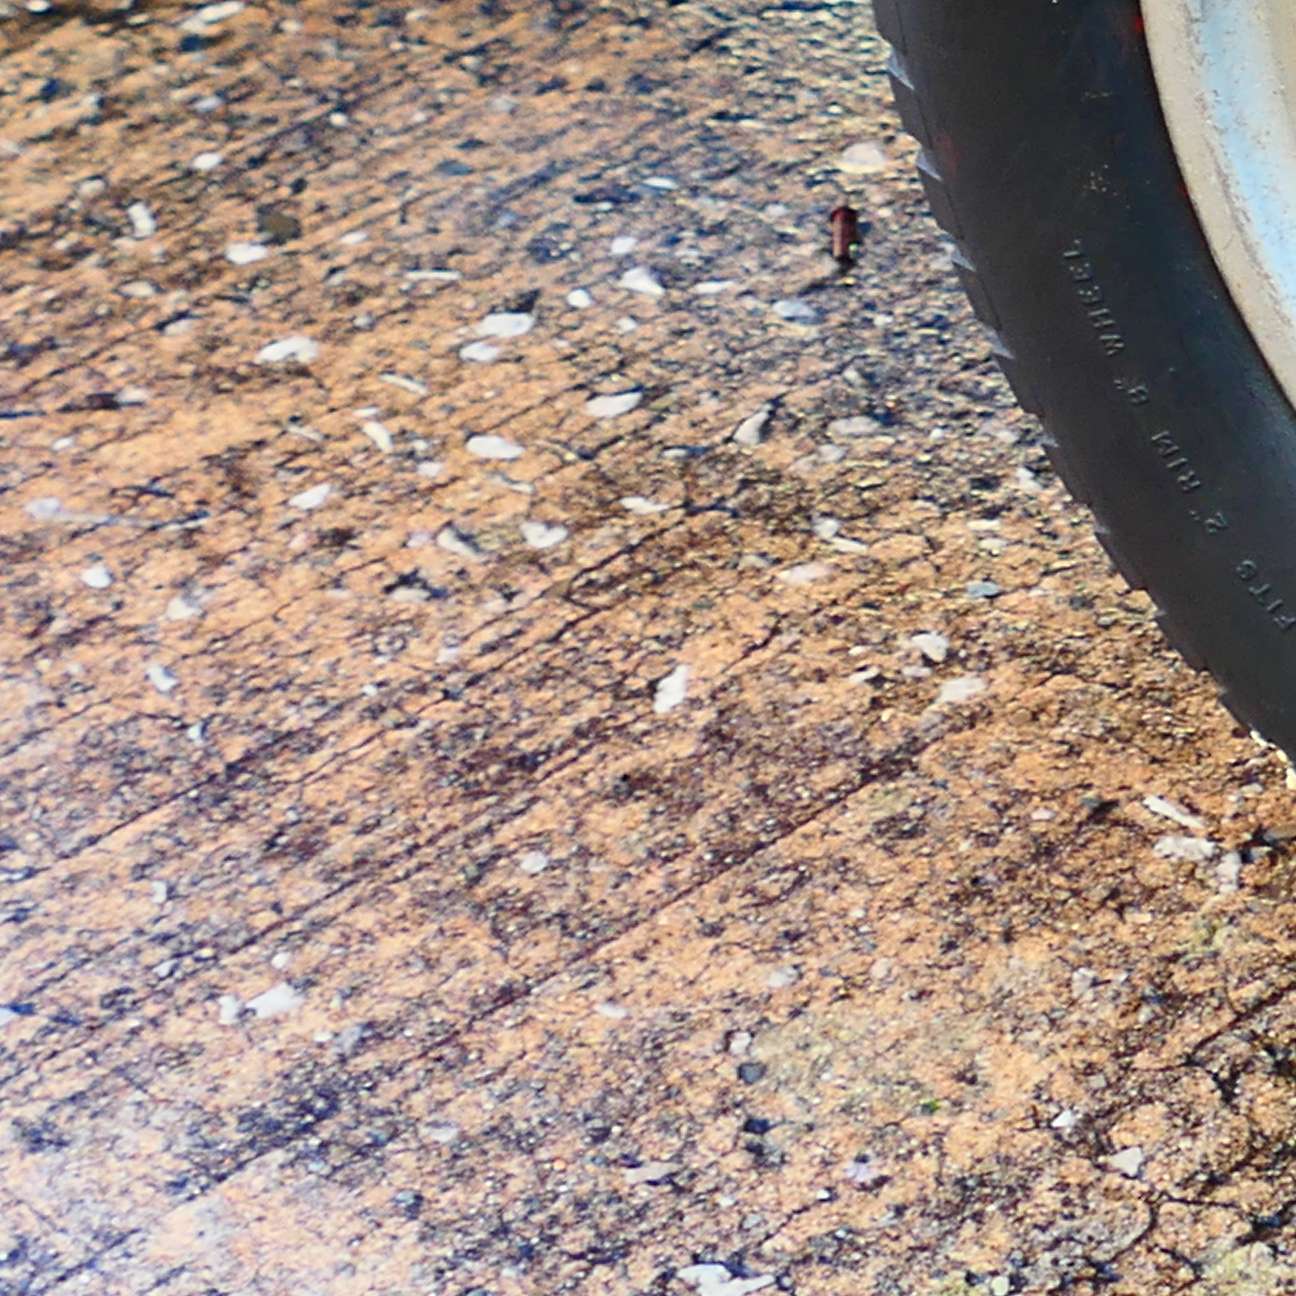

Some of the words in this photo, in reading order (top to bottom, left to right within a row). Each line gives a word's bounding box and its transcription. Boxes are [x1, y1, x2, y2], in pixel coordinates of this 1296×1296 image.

[1063, 238, 1126, 357] WHEEL
[1150, 429, 1200, 494] RIM
[1235, 558, 1296, 632] FITS
